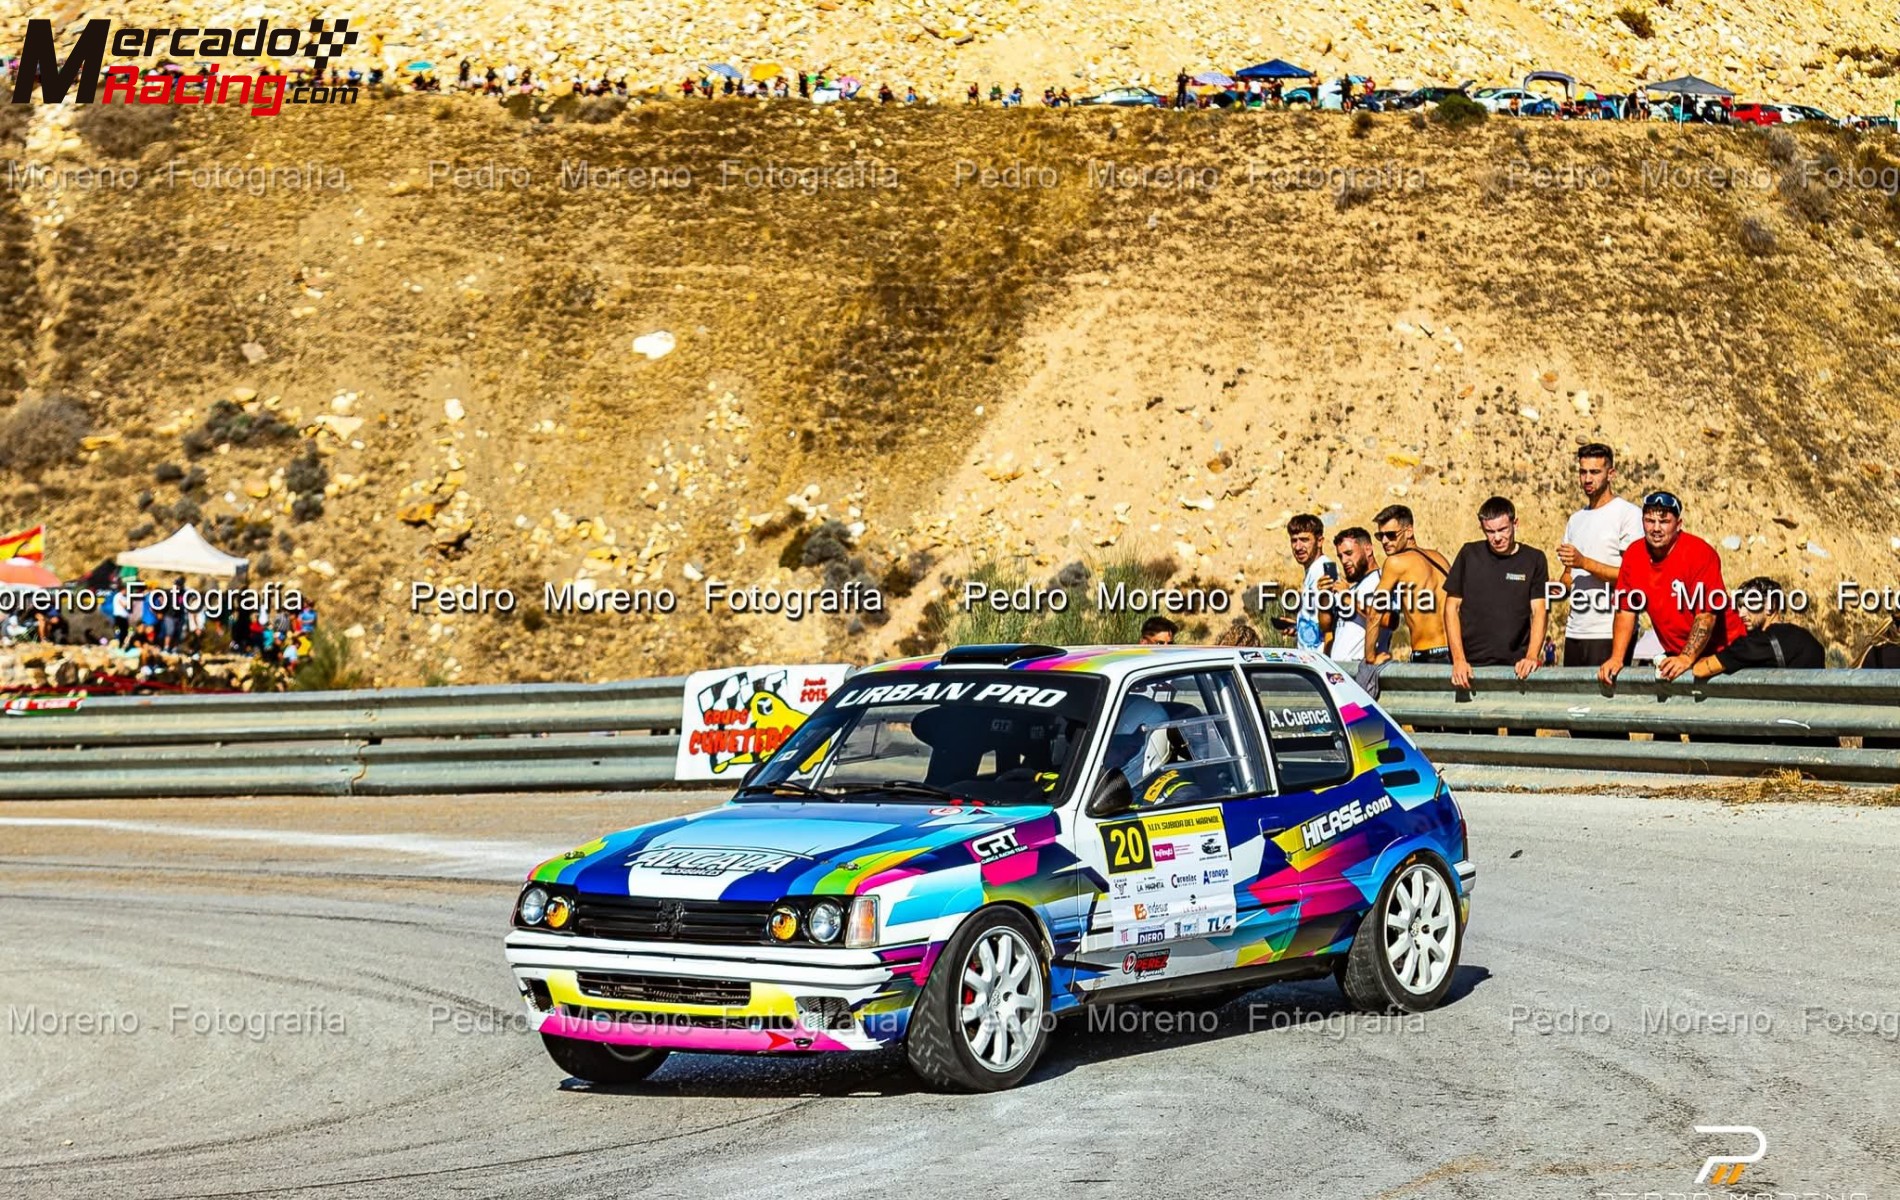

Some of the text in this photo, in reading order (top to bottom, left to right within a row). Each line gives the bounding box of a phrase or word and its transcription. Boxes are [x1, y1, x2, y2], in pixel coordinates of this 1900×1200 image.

[800, 687, 828, 702] 2015
[835, 682, 1068, 709] URBAN PRO
[971, 827, 1019, 857] CRT
[1110, 826, 1145, 866] 20
